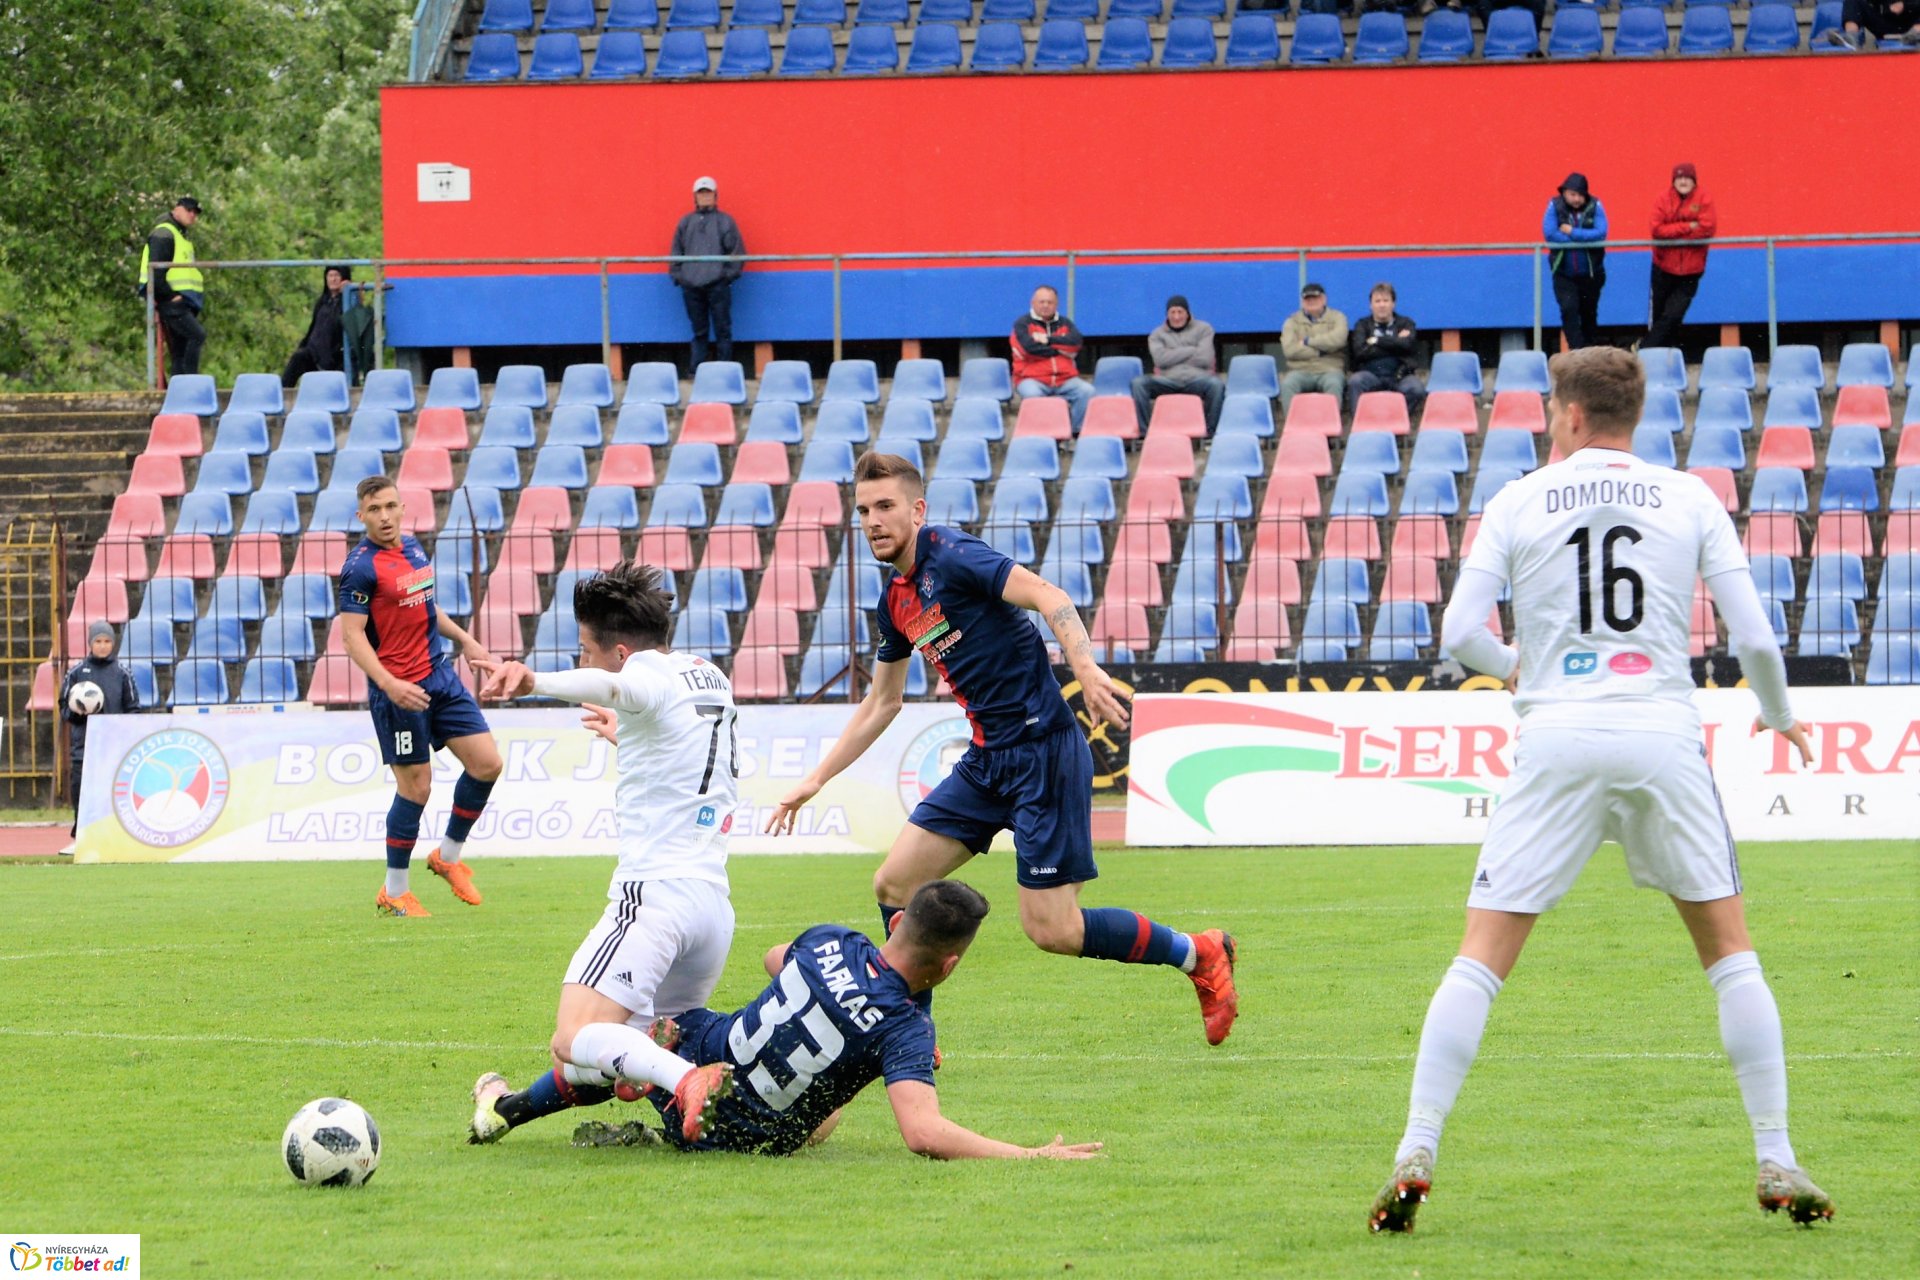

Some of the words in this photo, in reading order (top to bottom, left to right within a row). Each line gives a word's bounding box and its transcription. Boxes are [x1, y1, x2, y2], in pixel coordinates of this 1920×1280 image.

[1546, 479, 1663, 514] DOMOKOS
[1564, 524, 1645, 635] 16
[394, 731, 414, 755] 18
[813, 940, 885, 1033] FARKAS
[728, 957, 845, 1112] 33
